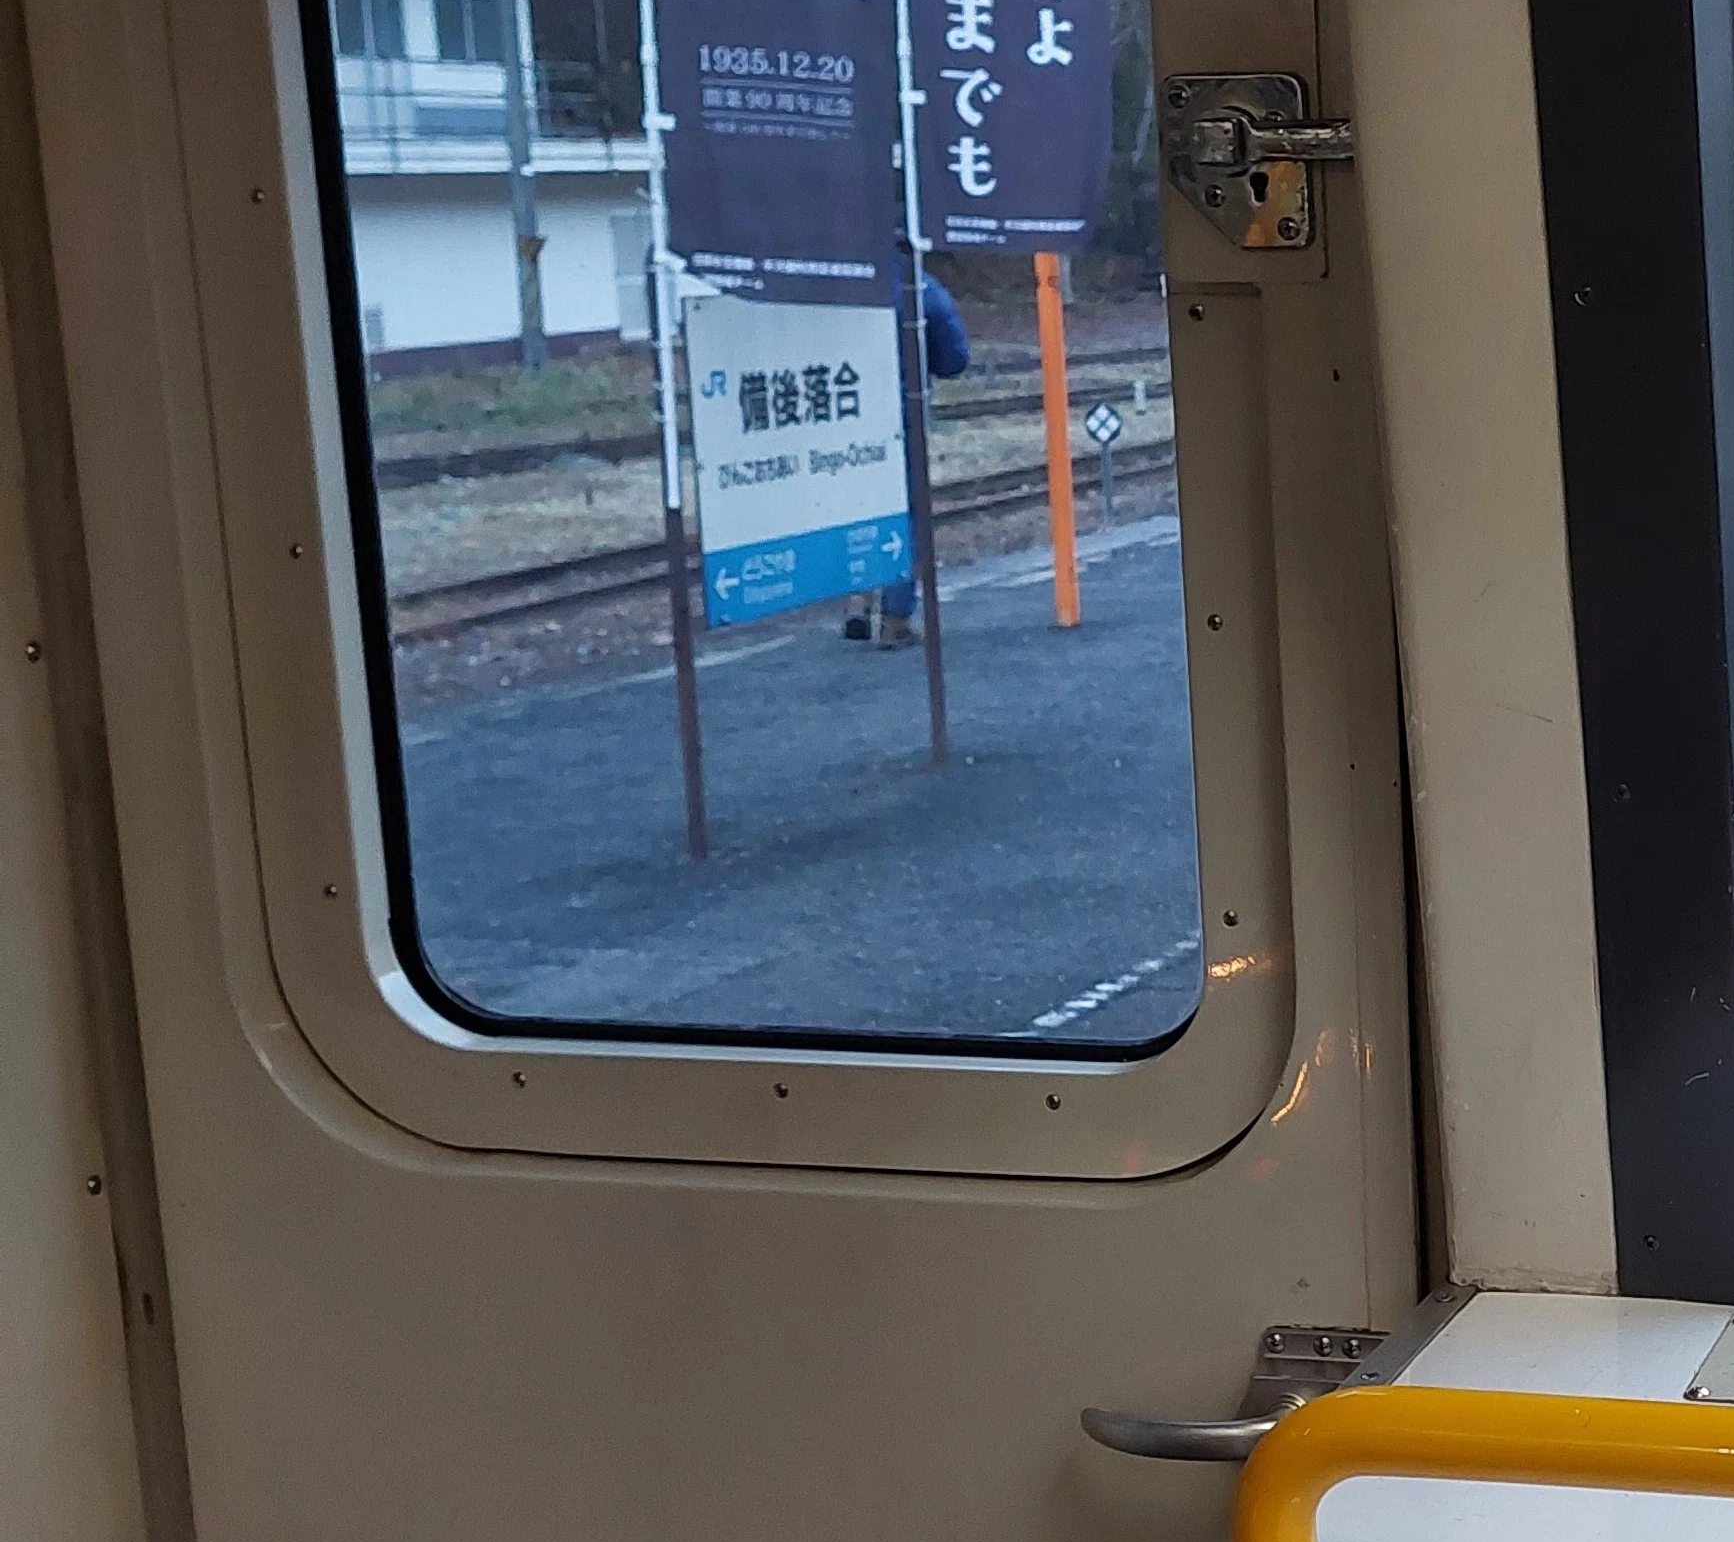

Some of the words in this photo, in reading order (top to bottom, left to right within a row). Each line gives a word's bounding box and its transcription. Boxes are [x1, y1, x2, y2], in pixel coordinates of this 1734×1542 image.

[699, 43, 855, 84] 1935.12.20
[701, 369, 727, 399] JR
[738, 360, 861, 434] 備後落合
